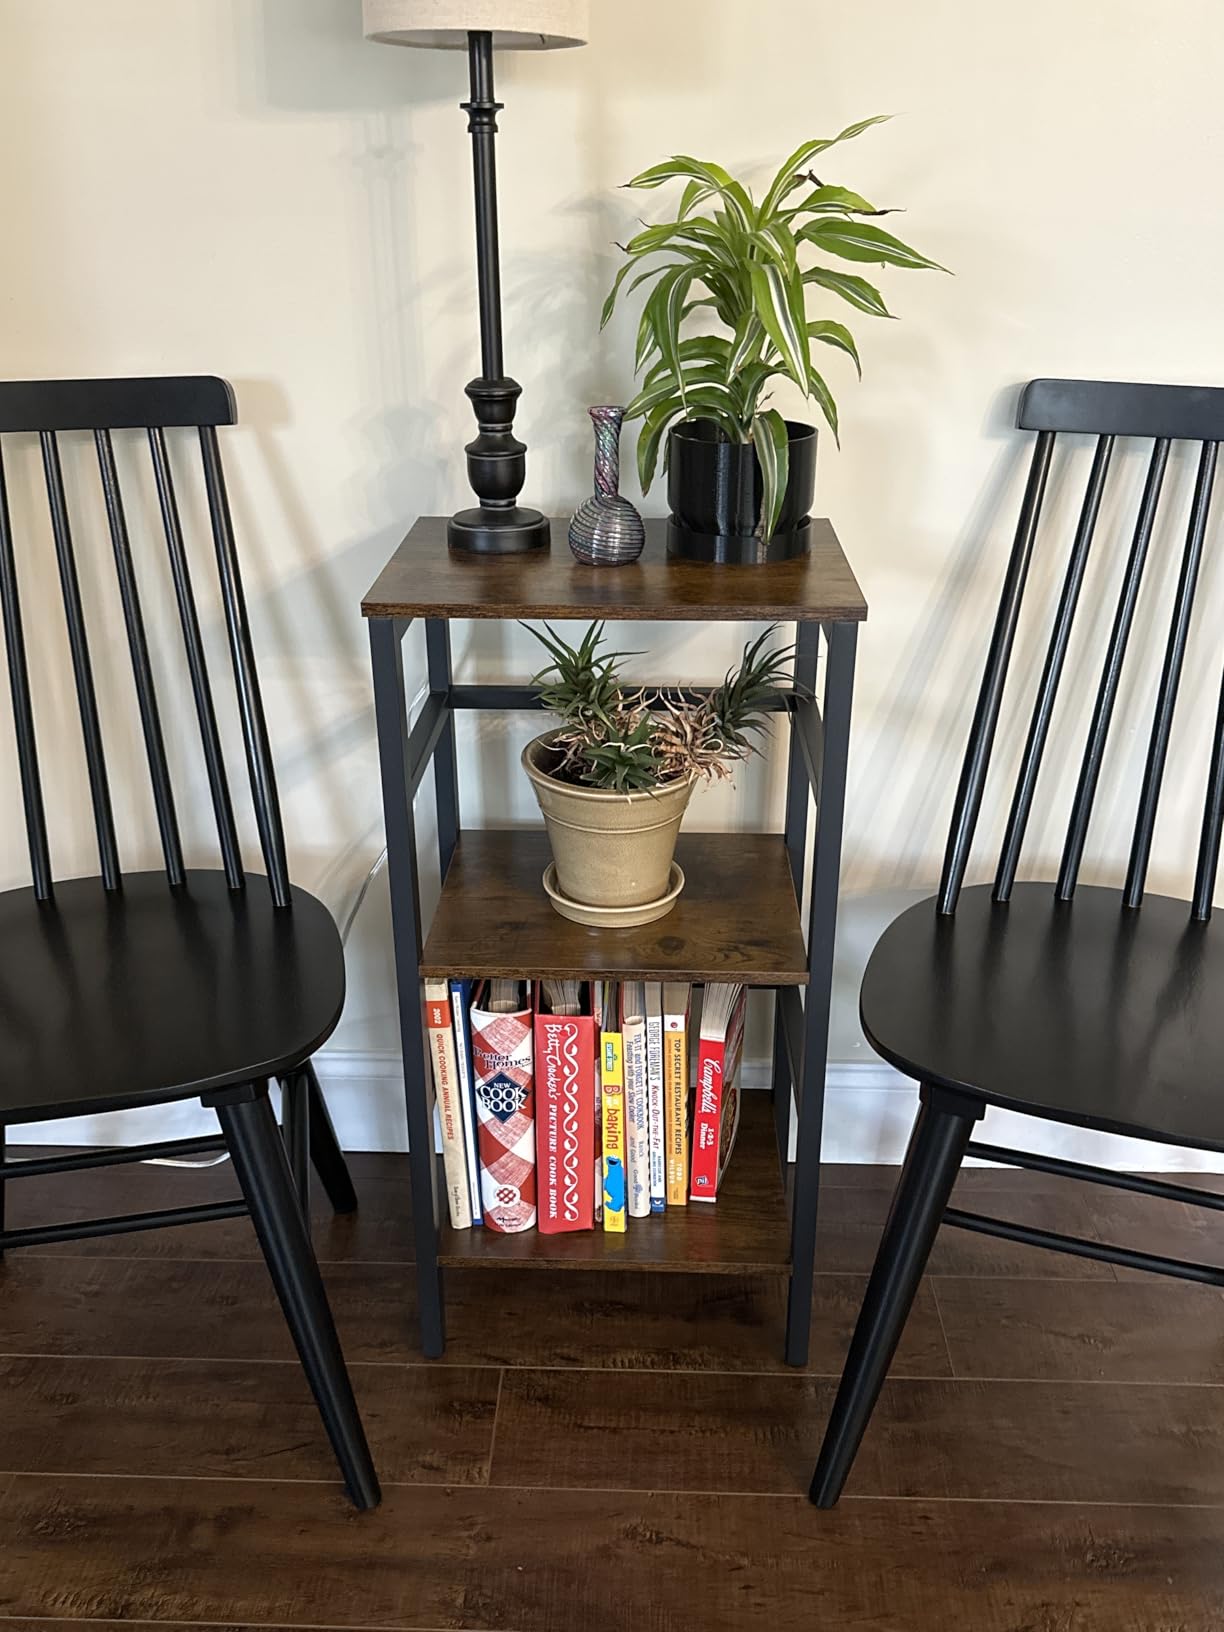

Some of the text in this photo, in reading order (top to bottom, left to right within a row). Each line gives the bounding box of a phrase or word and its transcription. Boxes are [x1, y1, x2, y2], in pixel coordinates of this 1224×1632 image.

[433, 1008, 443, 1025] 2002
[649, 1021, 660, 1045] GEORGE
[649, 1046, 661, 1081] FOREMAN'S
[436, 1033, 454, 1140] QUICK COOKING ANNUAL RECIPES
[480, 1085, 529, 1101] COOK
[699, 1058, 721, 1114] Campbell's
[482, 1097, 527, 1112] BOOK
[542, 1024, 563, 1219] Betty Crocker's PICTURE COOK BOOK
[636, 1097, 645, 1130] COOKBOOK
[674, 1082, 682, 1127] RESTAURANT
[605, 1108, 621, 1150] baking
[699, 1122, 708, 1150] Dinner
